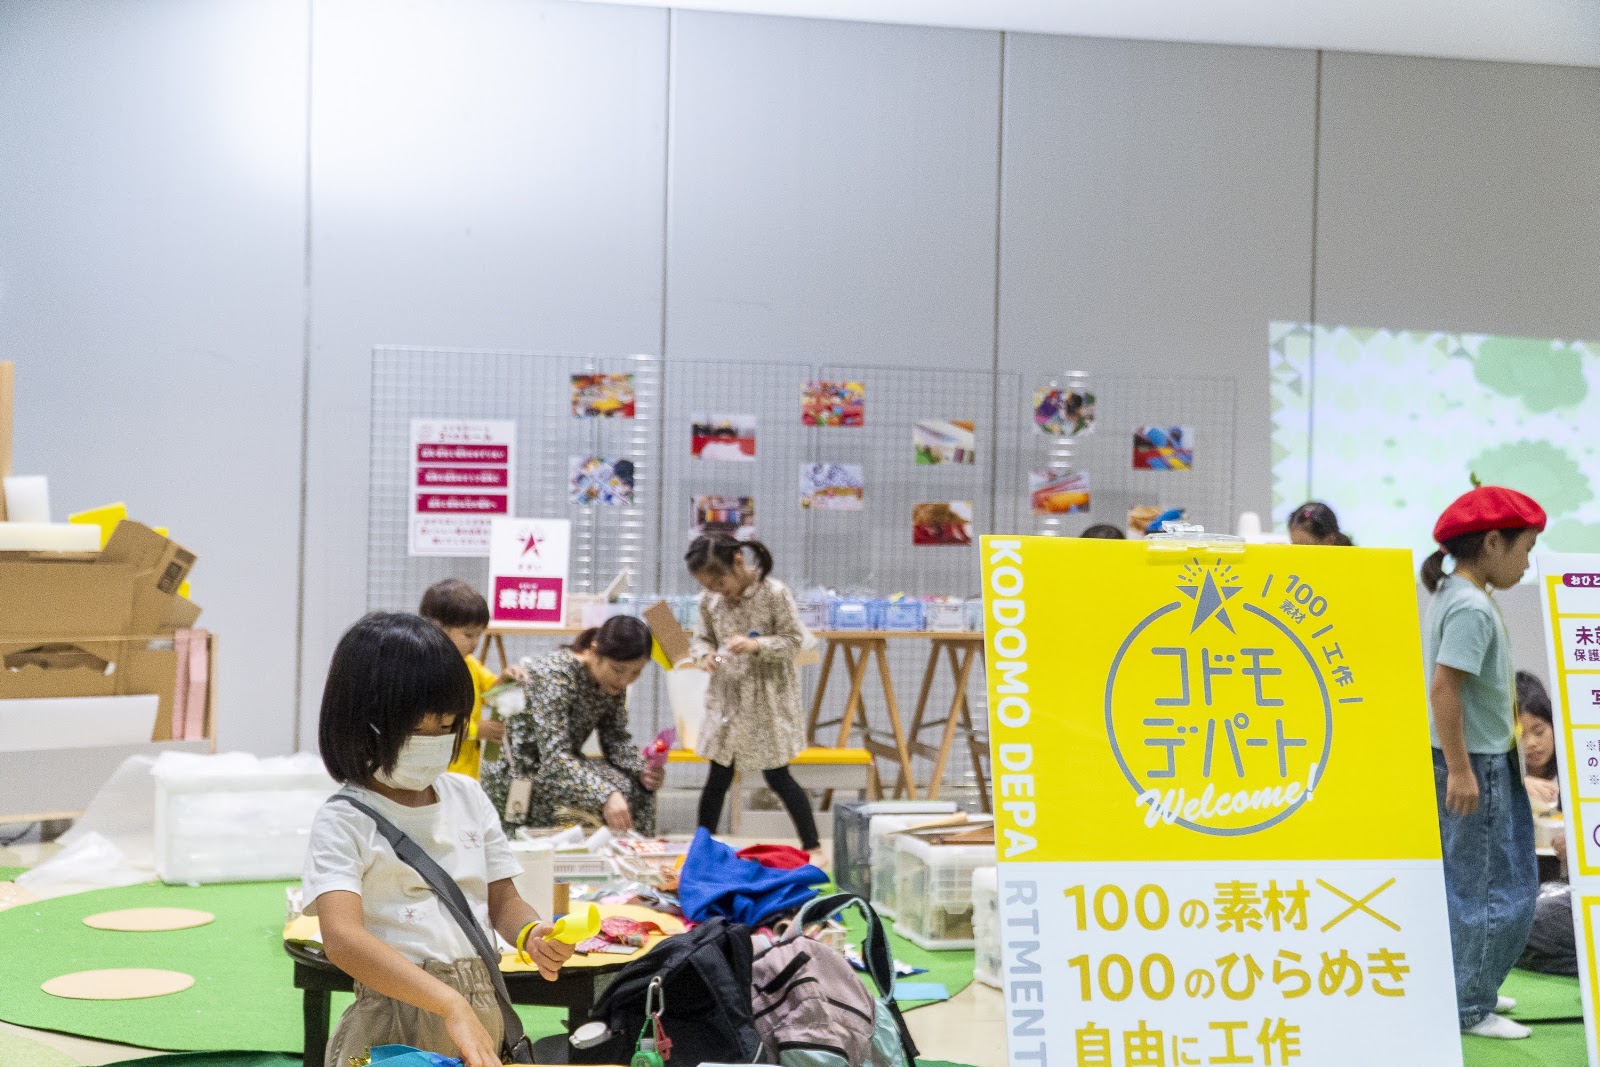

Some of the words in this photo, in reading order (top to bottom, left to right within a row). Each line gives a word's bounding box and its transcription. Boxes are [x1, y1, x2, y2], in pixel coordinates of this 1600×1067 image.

[1279, 599, 1306, 624] 素材
[1285, 574, 1328, 617] 100
[989, 540, 1031, 728] KODOMO
[1151, 647, 1285, 706] コドモ
[1322, 642, 1354, 687] 工作
[1143, 712, 1307, 778] デパート
[1136, 762, 1318, 828] Welcome!
[1068, 947, 1410, 1002] 100のひらめき
[1075, 1017, 1301, 1067] 自由に工作
